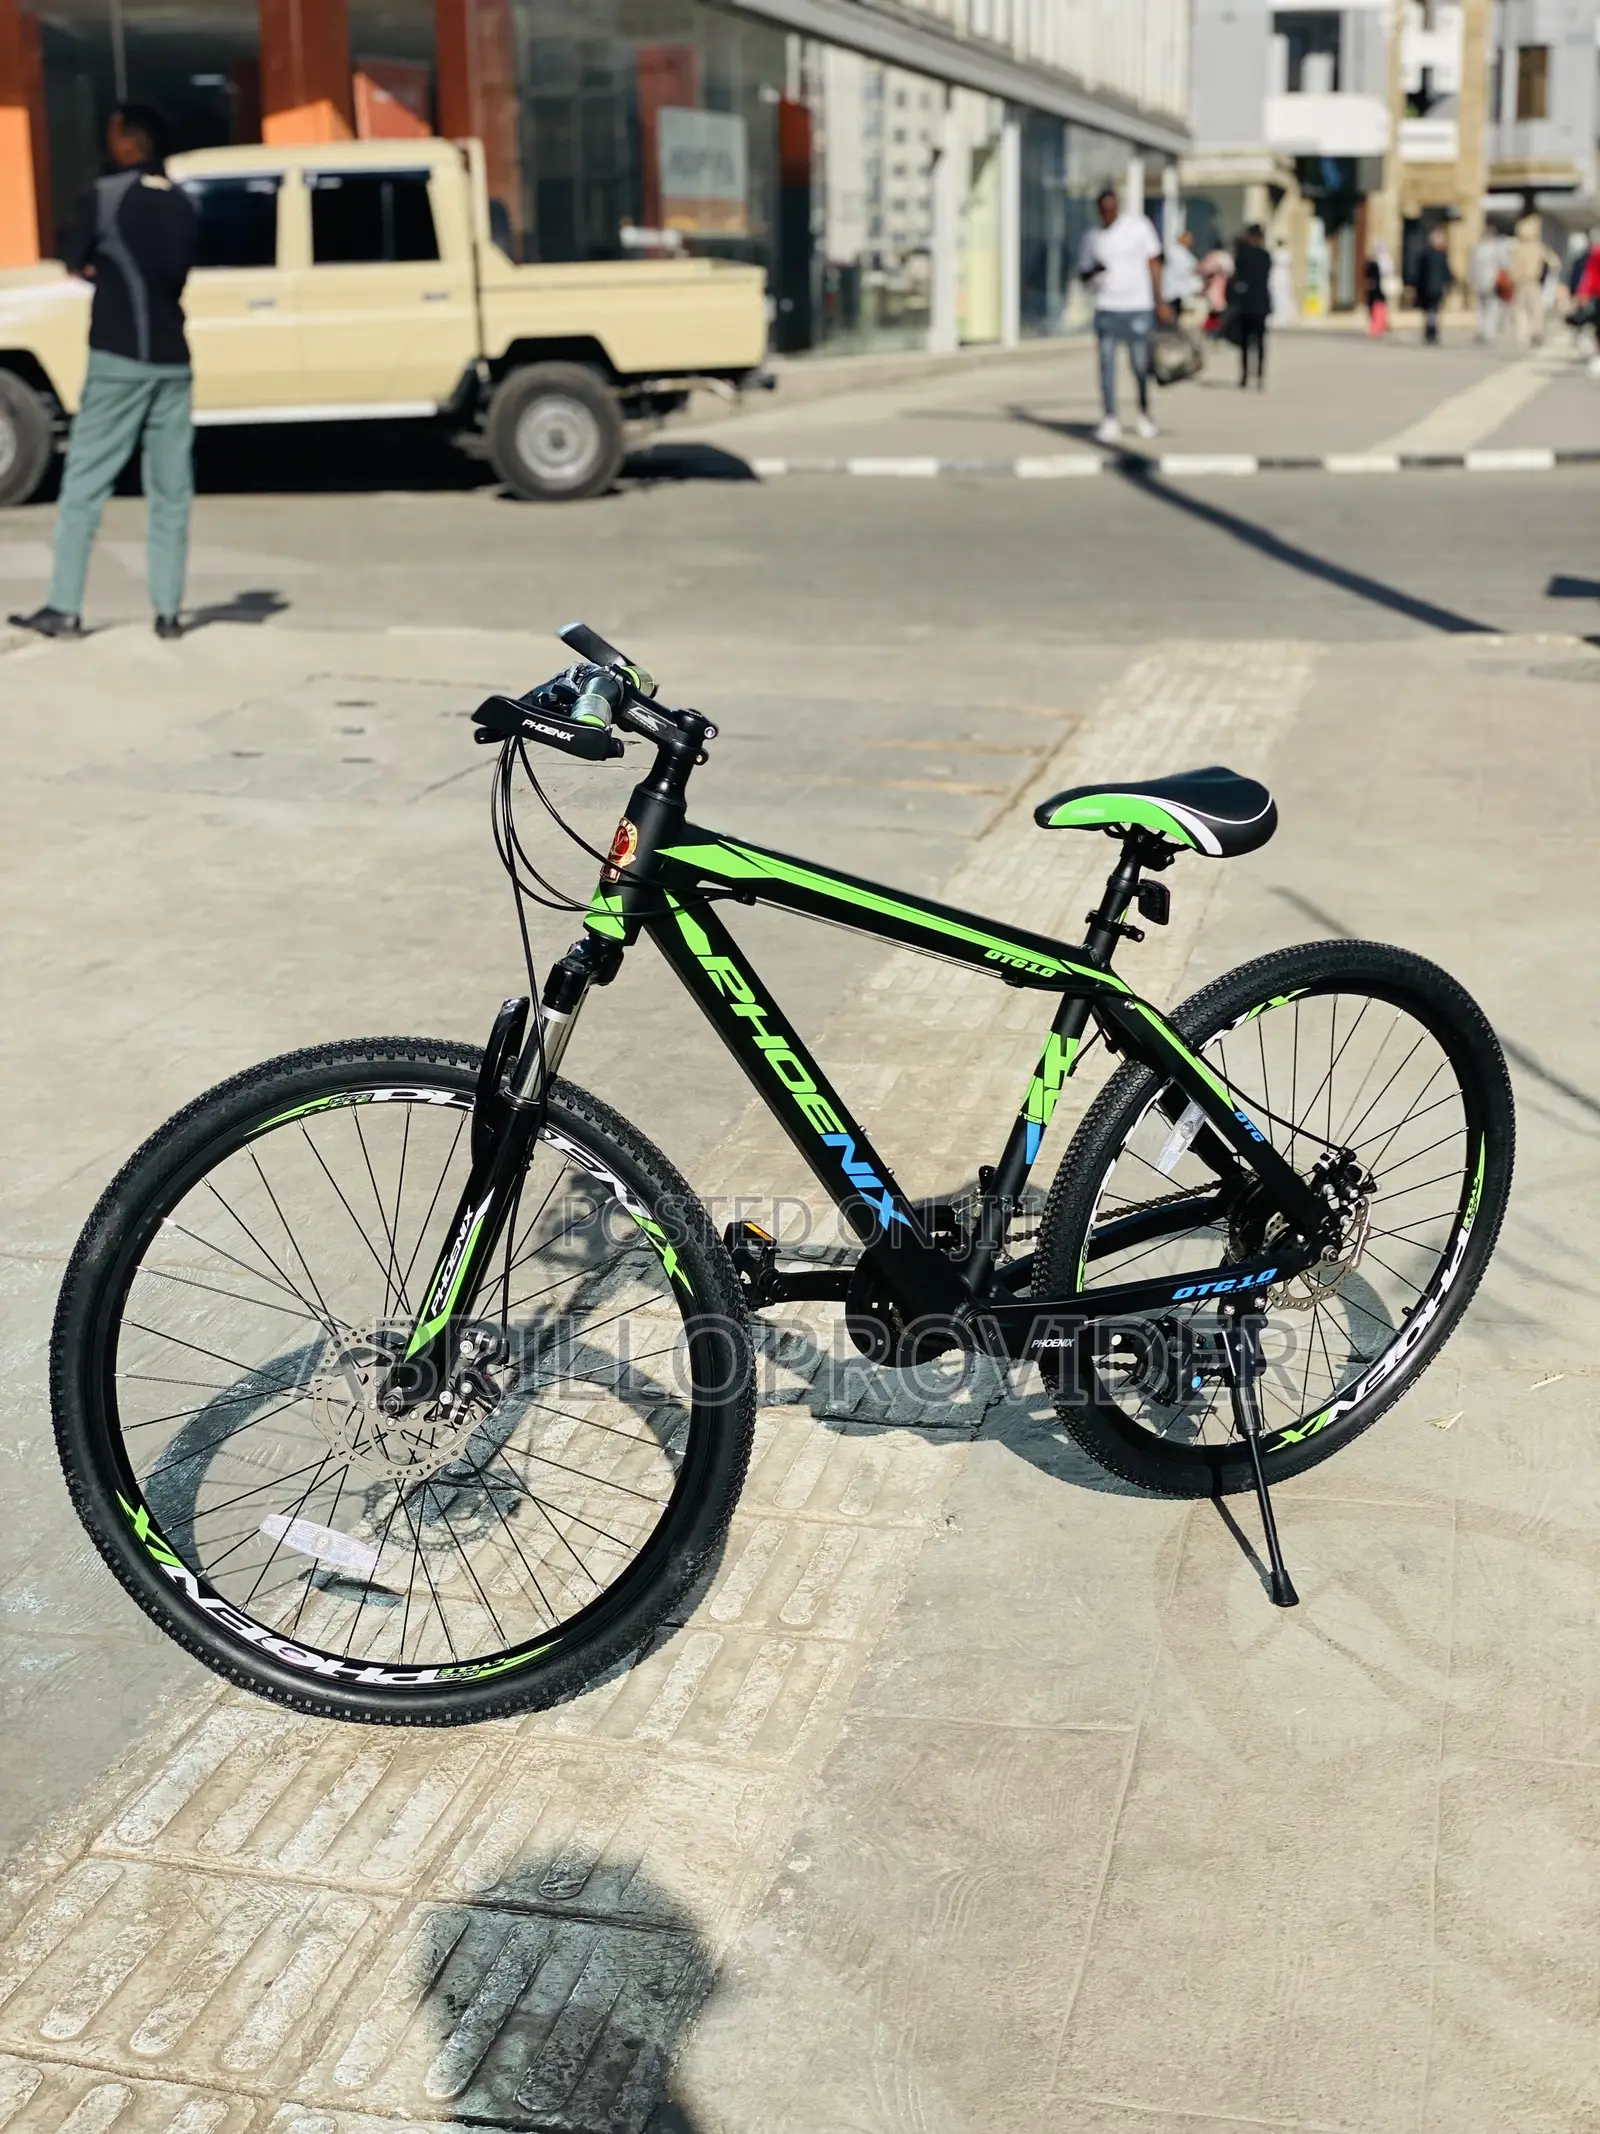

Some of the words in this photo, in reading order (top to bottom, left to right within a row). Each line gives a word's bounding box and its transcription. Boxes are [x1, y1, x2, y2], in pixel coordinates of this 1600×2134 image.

[521, 718, 575, 742] PHOENIX
[698, 956, 912, 1231] PHOENIX
[1234, 1111, 1265, 1143] OTG
[431, 1204, 473, 1317] PHOENIX
[1031, 1338, 1075, 1348] PHOENIX
[1266, 1227, 1470, 1453] PHOENIX
[115, 1489, 440, 1685] PHOENIX
